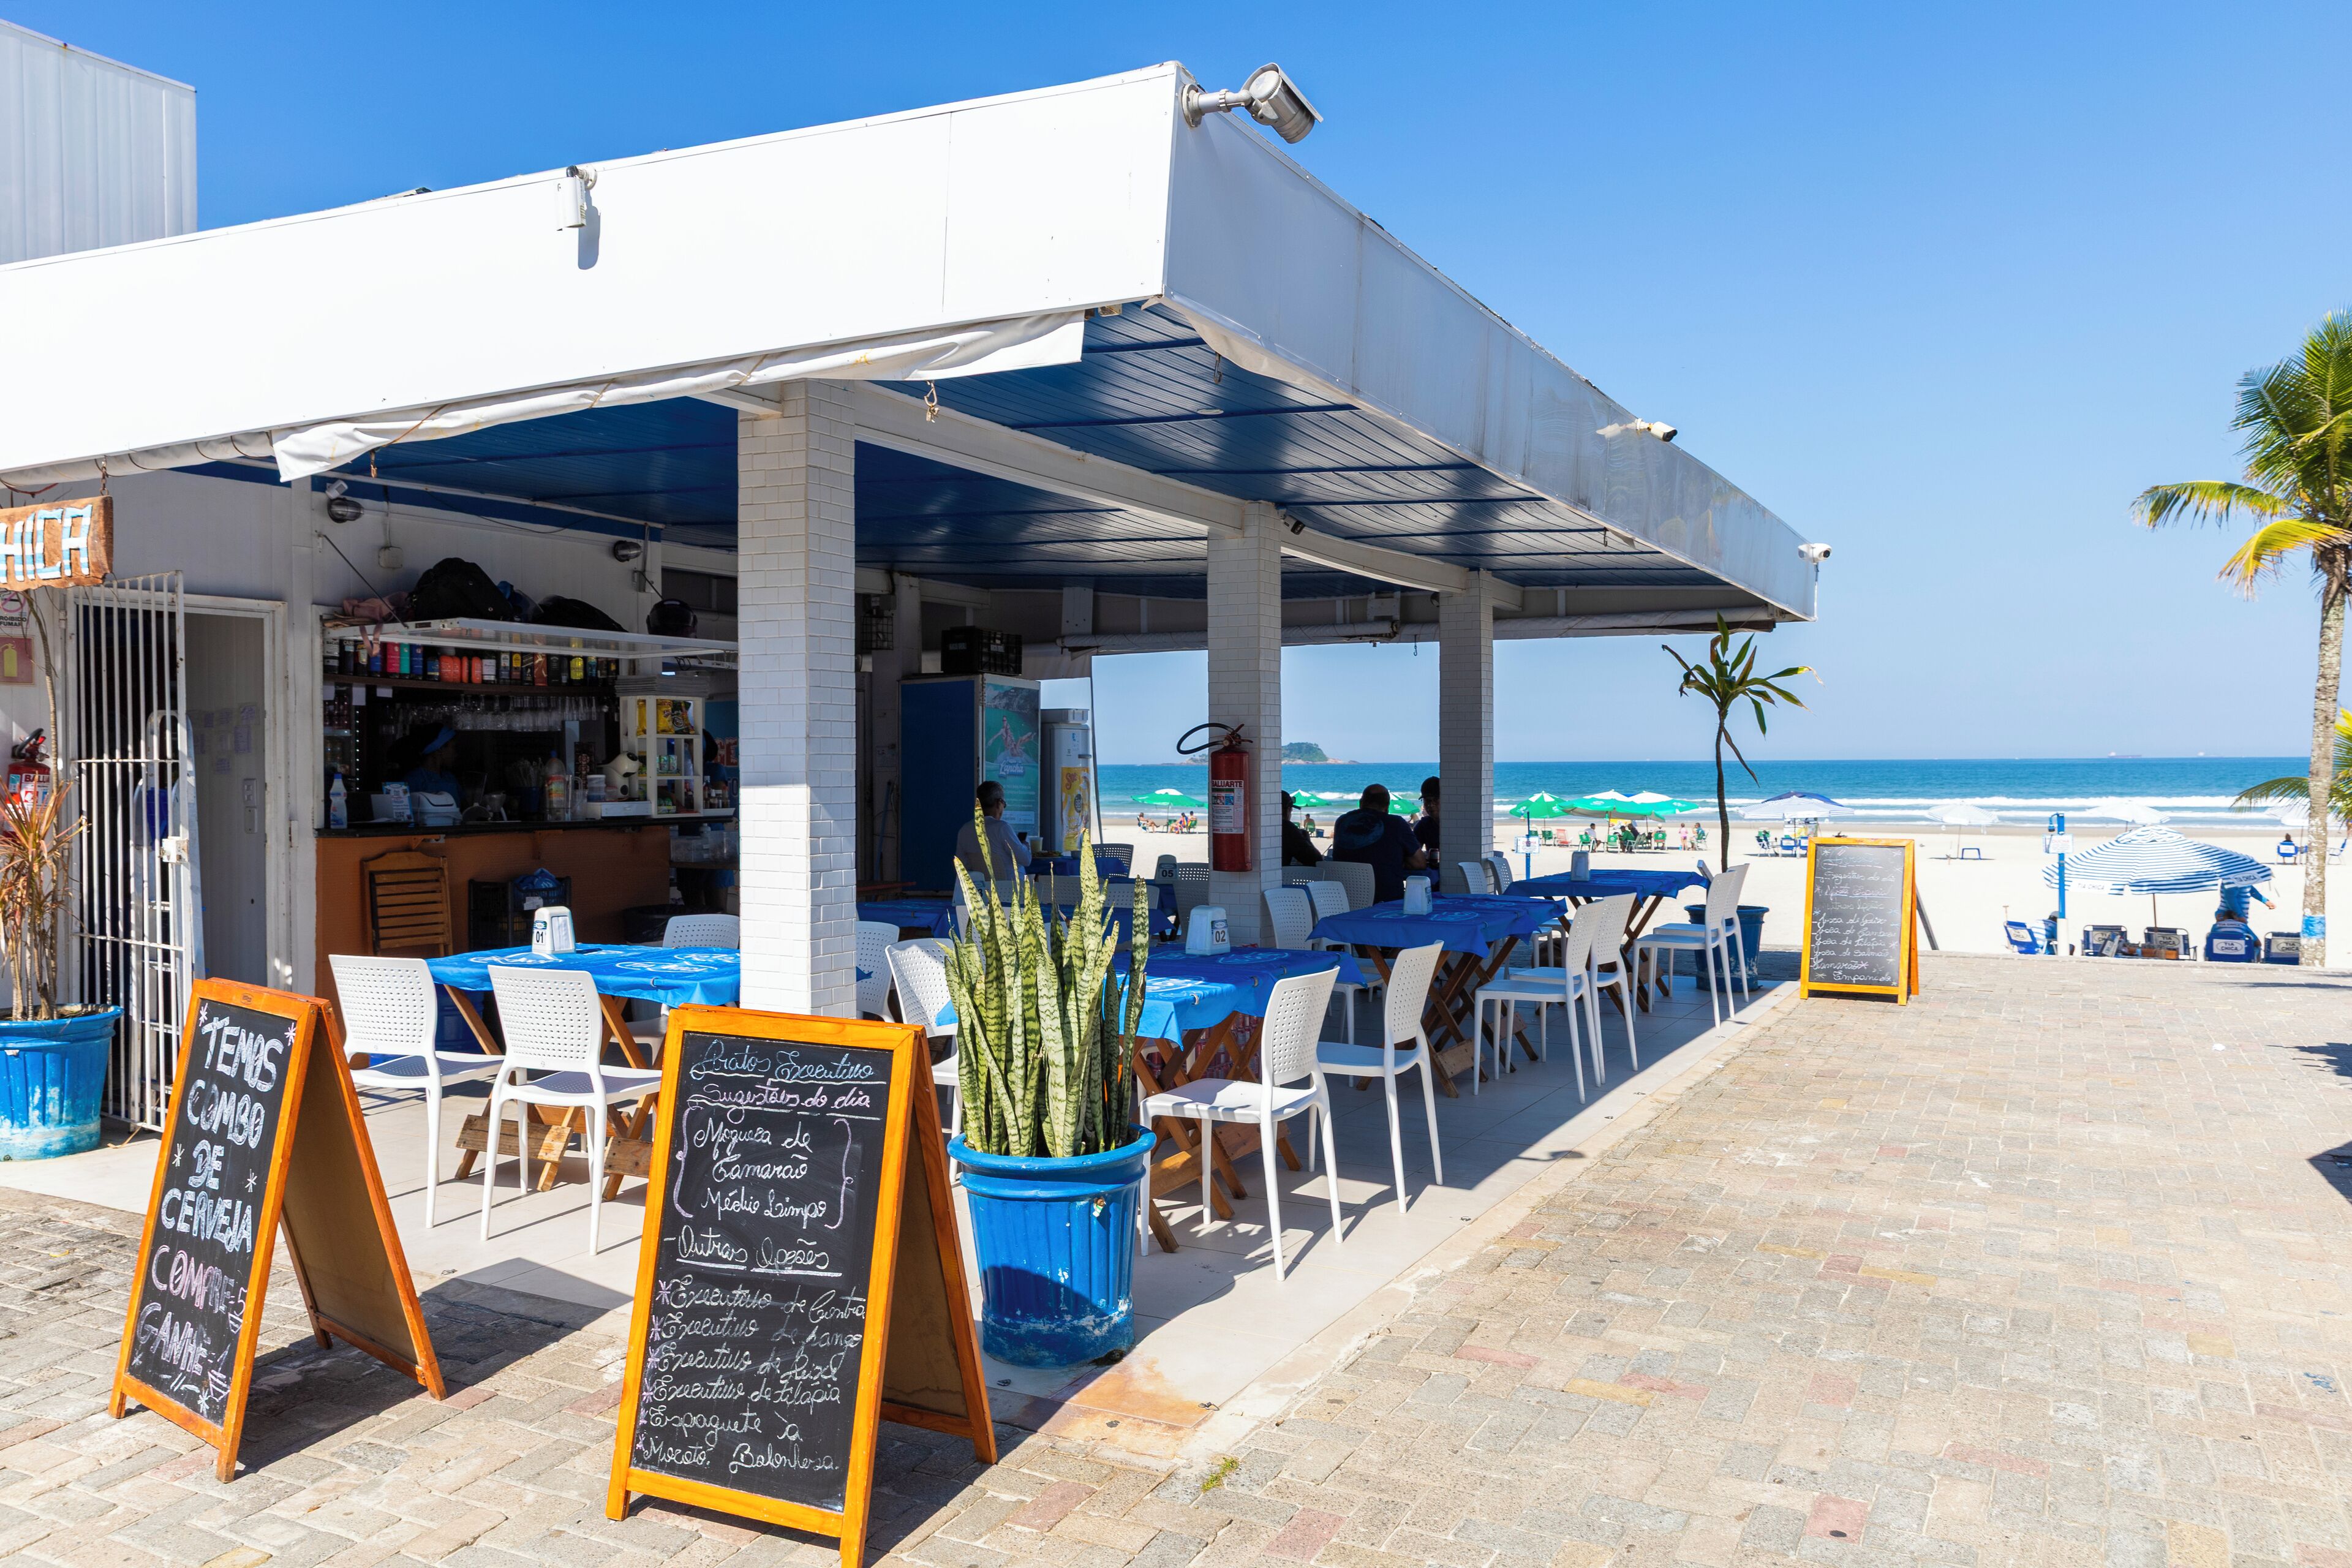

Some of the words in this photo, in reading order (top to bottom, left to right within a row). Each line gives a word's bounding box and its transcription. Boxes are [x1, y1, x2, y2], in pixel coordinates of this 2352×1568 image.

[1161, 869, 1174, 878] 05
[536, 930, 544, 943] 01
[1215, 930, 1226, 943] 02
[201, 1016, 284, 1092] TEMOS
[690, 1039, 771, 1080] Pratos
[775, 1050, 875, 1080] Executivo
[187, 1079, 265, 1149] COMBO
[688, 1080, 800, 1124] Sugestões
[801, 1086, 827, 1107] do
[831, 1087, 871, 1109] dia
[782, 1121, 813, 1153] de
[188, 1139, 225, 1190] DE
[712, 1154, 808, 1182] Camarão
[160, 1188, 252, 1253] CERVEJA
[701, 1186, 760, 1220] Médio
[764, 1189, 826, 1229] Limpo
[756, 1236, 829, 1272] Opções
[670, 1274, 772, 1309] Executivo
[780, 1286, 806, 1313] de
[661, 1310, 760, 1340] Executivo
[771, 1315, 796, 1344] de
[658, 1341, 752, 1372] Executivo
[755, 1347, 781, 1376] de
[653, 1374, 745, 1401] Executivo
[748, 1378, 772, 1401] de
[649, 1403, 763, 1447] Espaguete
[774, 1410, 804, 1442] à
